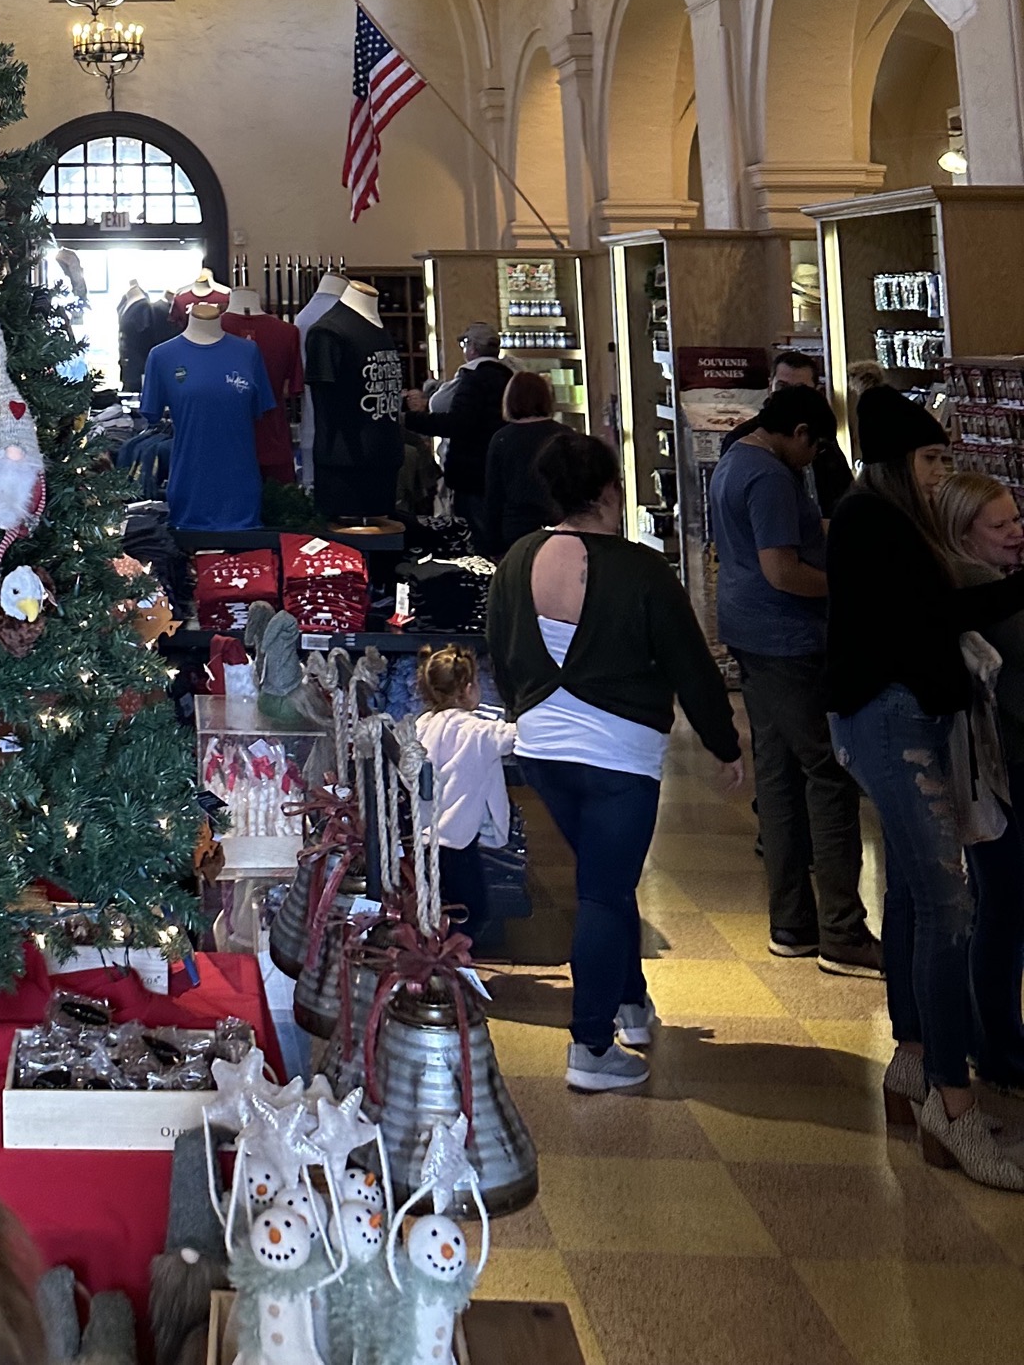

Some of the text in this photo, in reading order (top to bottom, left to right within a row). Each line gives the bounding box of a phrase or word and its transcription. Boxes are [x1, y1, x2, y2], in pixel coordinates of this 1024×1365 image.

[105, 212, 126, 228] EXIT
[698, 358, 748, 367] SOUVENIR
[704, 370, 745, 378] PENNIES
[304, 559, 354, 570] TEXAS
[212, 567, 260, 578] TEXAS
